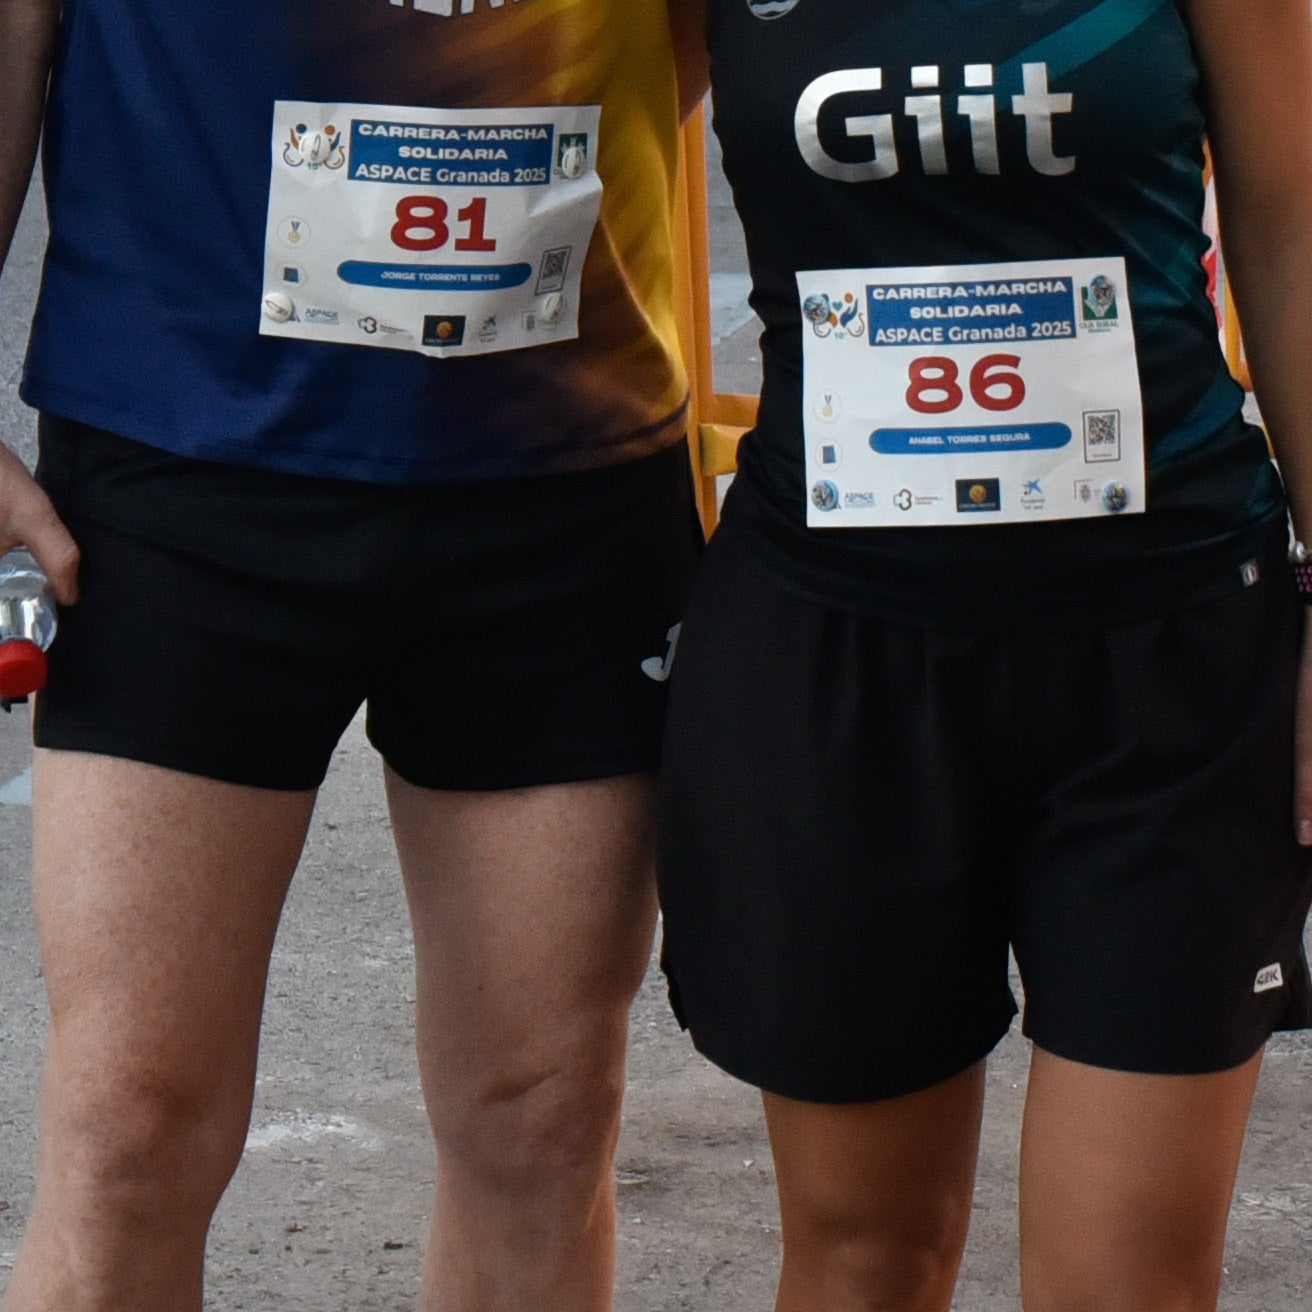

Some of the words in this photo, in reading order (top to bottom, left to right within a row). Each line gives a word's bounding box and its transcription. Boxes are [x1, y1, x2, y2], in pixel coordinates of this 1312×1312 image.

[794, 61, 1077, 183] Giit
[358, 123, 548, 141] CARRERA-MARCHA
[398, 145, 509, 161] SOLIDARIA
[355, 163, 432, 182] ASPACE
[436, 168, 510, 184] Granada
[514, 167, 547, 183] 2025
[390, 195, 497, 252] 81
[380, 271, 416, 281] JORGE
[418, 272, 468, 282] TORRENTE
[872, 281, 1068, 300] CARRERA-MARCHA
[909, 303, 1023, 320] SOLIDARIA
[875, 327, 944, 344] ASPACE
[948, 323, 1027, 342] Granada
[1031, 320, 1072, 338] 2025
[905, 353, 1026, 414] 86
[909, 436, 944, 445] ANABEL
[947, 434, 987, 444] TORRES
[989, 432, 1031, 443] SEGURA
